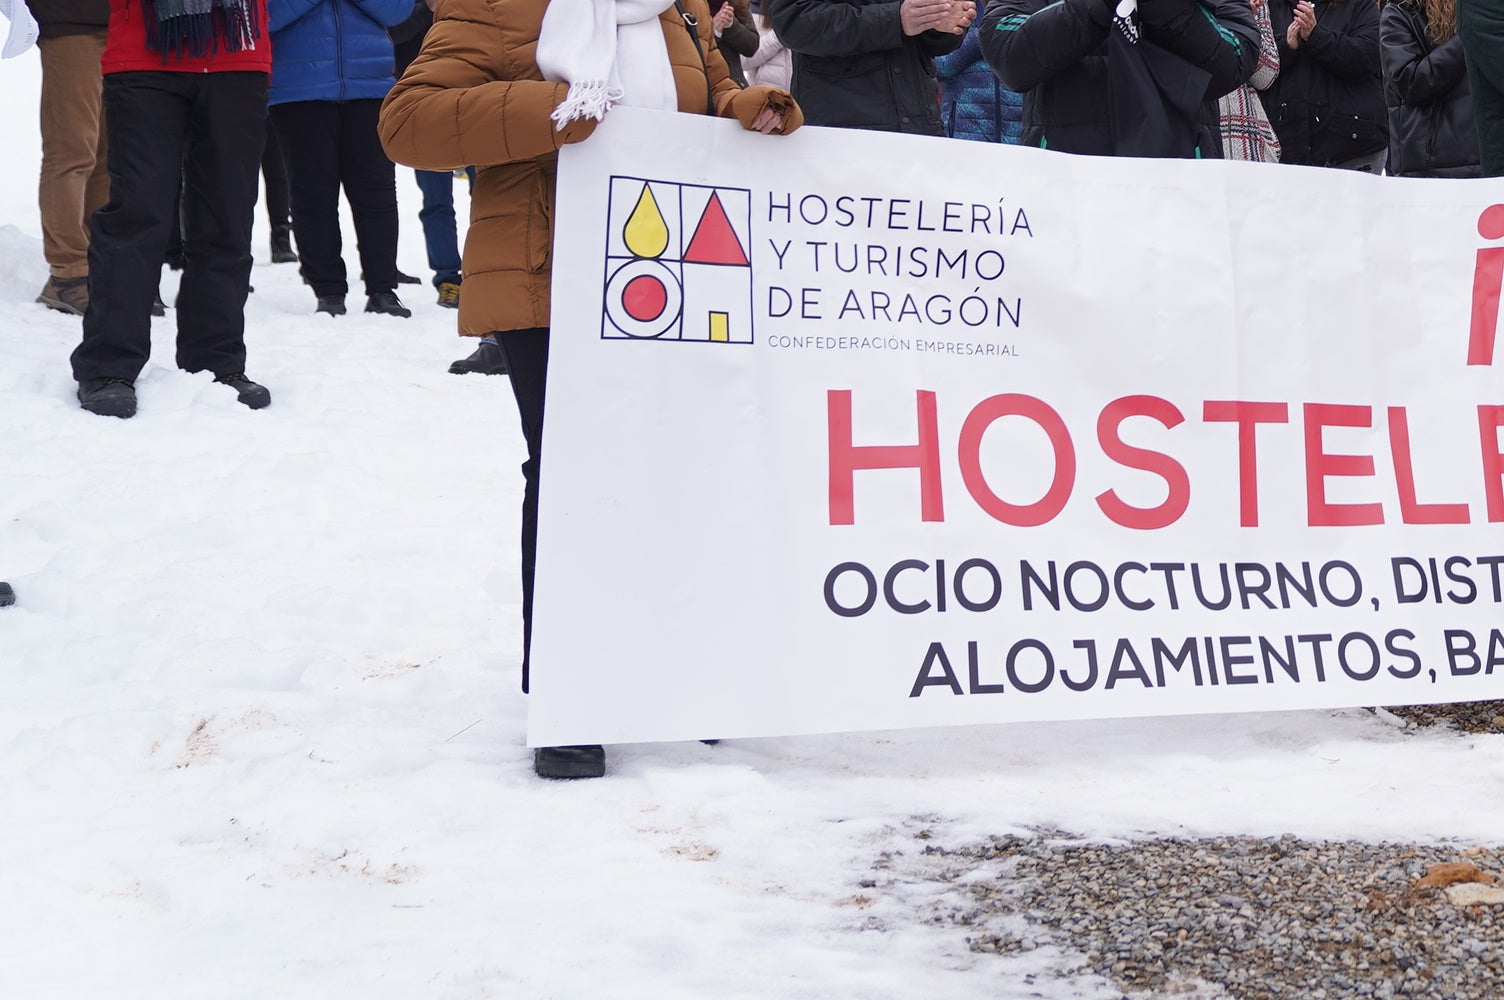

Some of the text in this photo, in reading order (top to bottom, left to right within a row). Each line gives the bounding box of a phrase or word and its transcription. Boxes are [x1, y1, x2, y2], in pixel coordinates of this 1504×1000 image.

[768, 191, 1033, 237] HOSTELERÍA
[769, 239, 1005, 280] Y TURISMO
[769, 286, 1022, 327] DE ARAGÓN
[769, 335, 1020, 357] CONFEDERACIÓN EMPRESARIAL
[824, 559, 1002, 618] OCIO
[1020, 559, 1380, 612] NOCTURNO,
[909, 629, 1437, 697] ALOJAMIENTOS,
